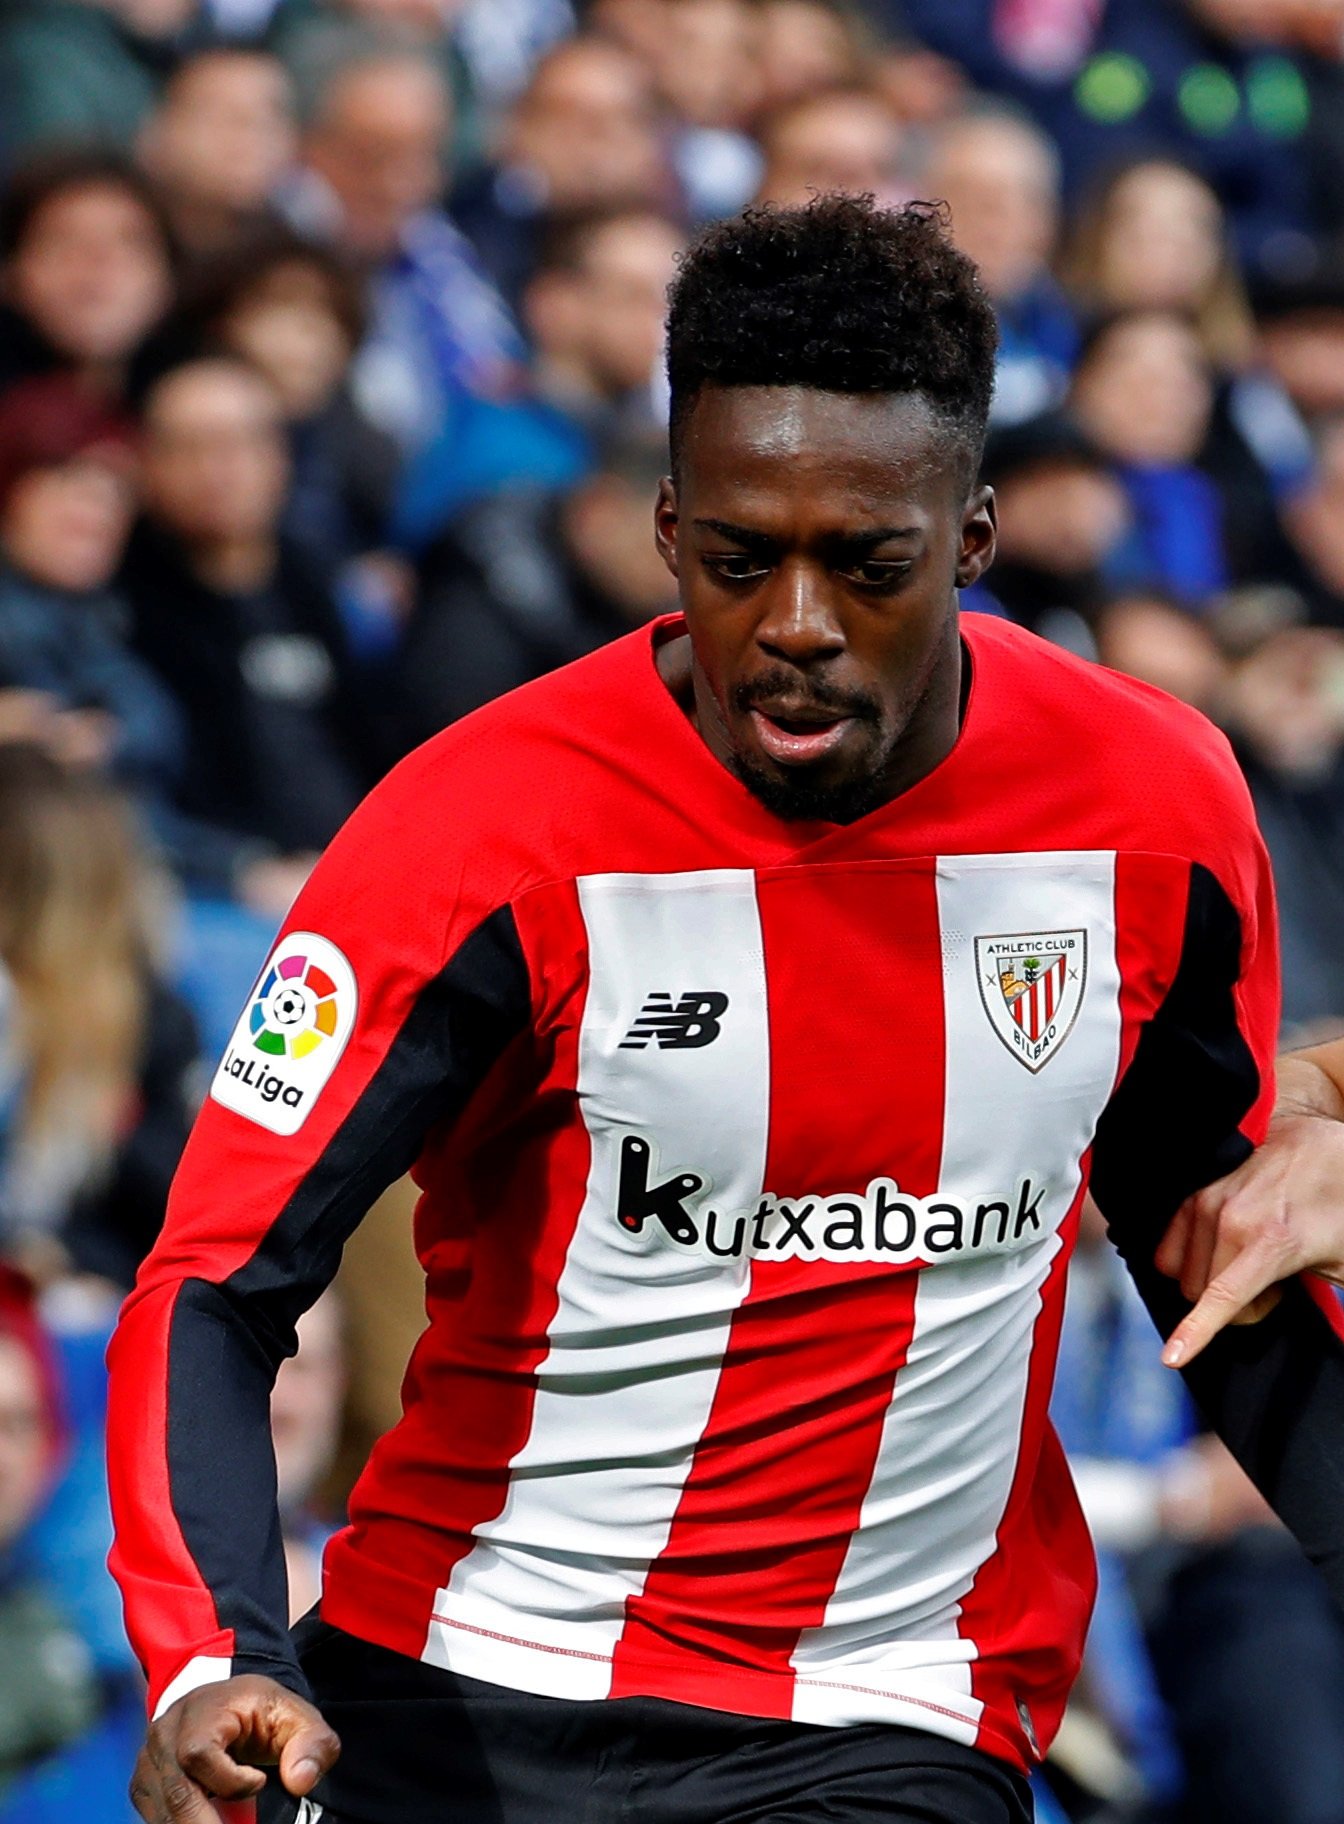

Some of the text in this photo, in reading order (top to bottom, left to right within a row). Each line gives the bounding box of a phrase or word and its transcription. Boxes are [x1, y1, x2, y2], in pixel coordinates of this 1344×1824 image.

[987, 939, 1075, 954] ATHLETIC CLUB
[617, 991, 729, 1050] NB
[1013, 1024, 1057, 1060] BILBAO
[224, 1048, 304, 1108] LaLiga
